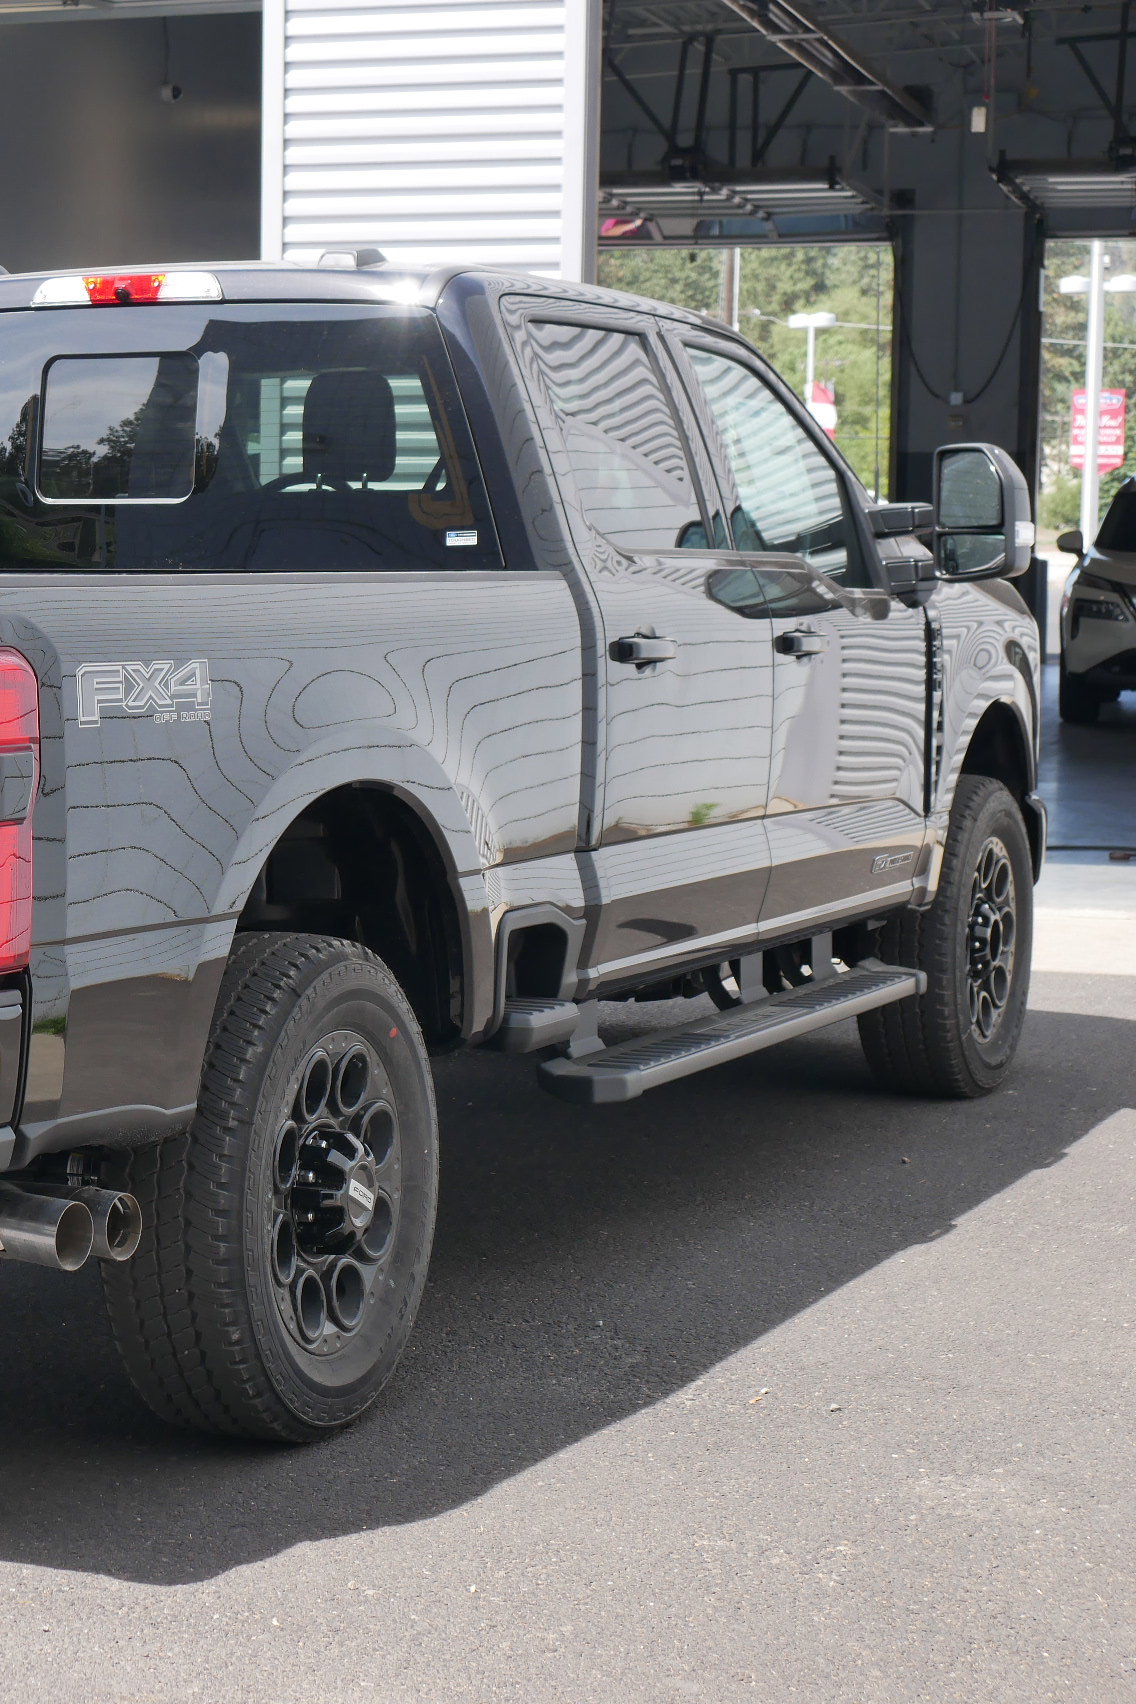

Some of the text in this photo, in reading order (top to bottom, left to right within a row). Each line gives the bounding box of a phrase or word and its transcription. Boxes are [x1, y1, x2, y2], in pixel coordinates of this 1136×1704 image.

[76, 659, 212, 728] FX4
[153, 711, 212, 724] OFF ROAD
[353, 1186, 372, 1204] FORD
